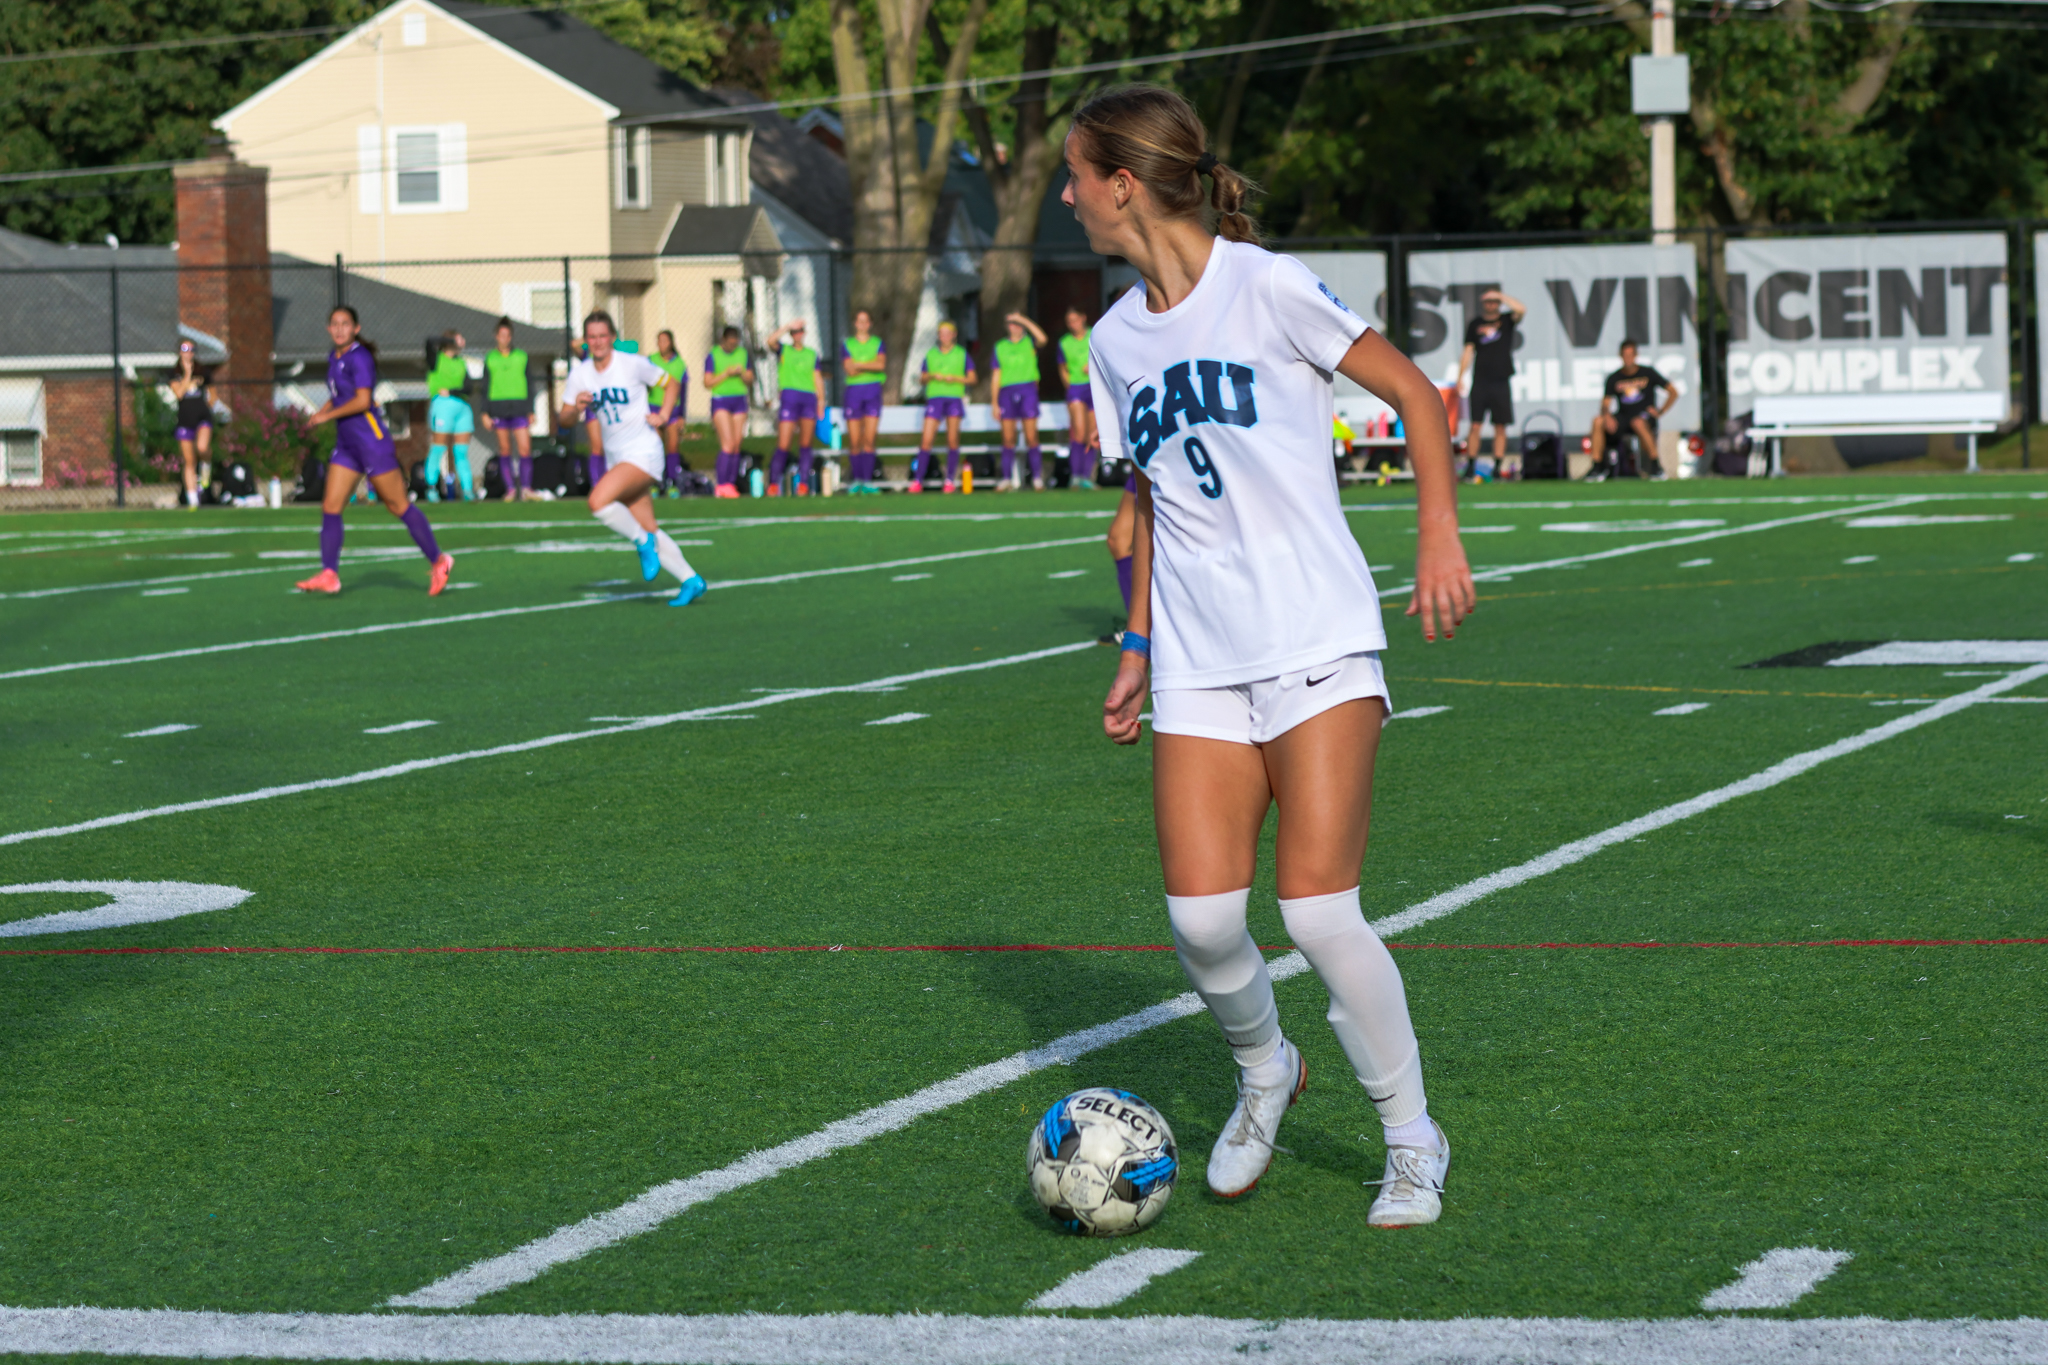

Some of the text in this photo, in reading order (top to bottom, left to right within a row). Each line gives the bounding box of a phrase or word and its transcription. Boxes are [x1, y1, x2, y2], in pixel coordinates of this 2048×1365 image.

[1727, 346, 1984, 396] COMPLEX
[603, 407, 621, 425] 11
[1128, 358, 1259, 469] SAU
[1183, 436, 1222, 499] 9
[1076, 1097, 1157, 1140] SELECT
